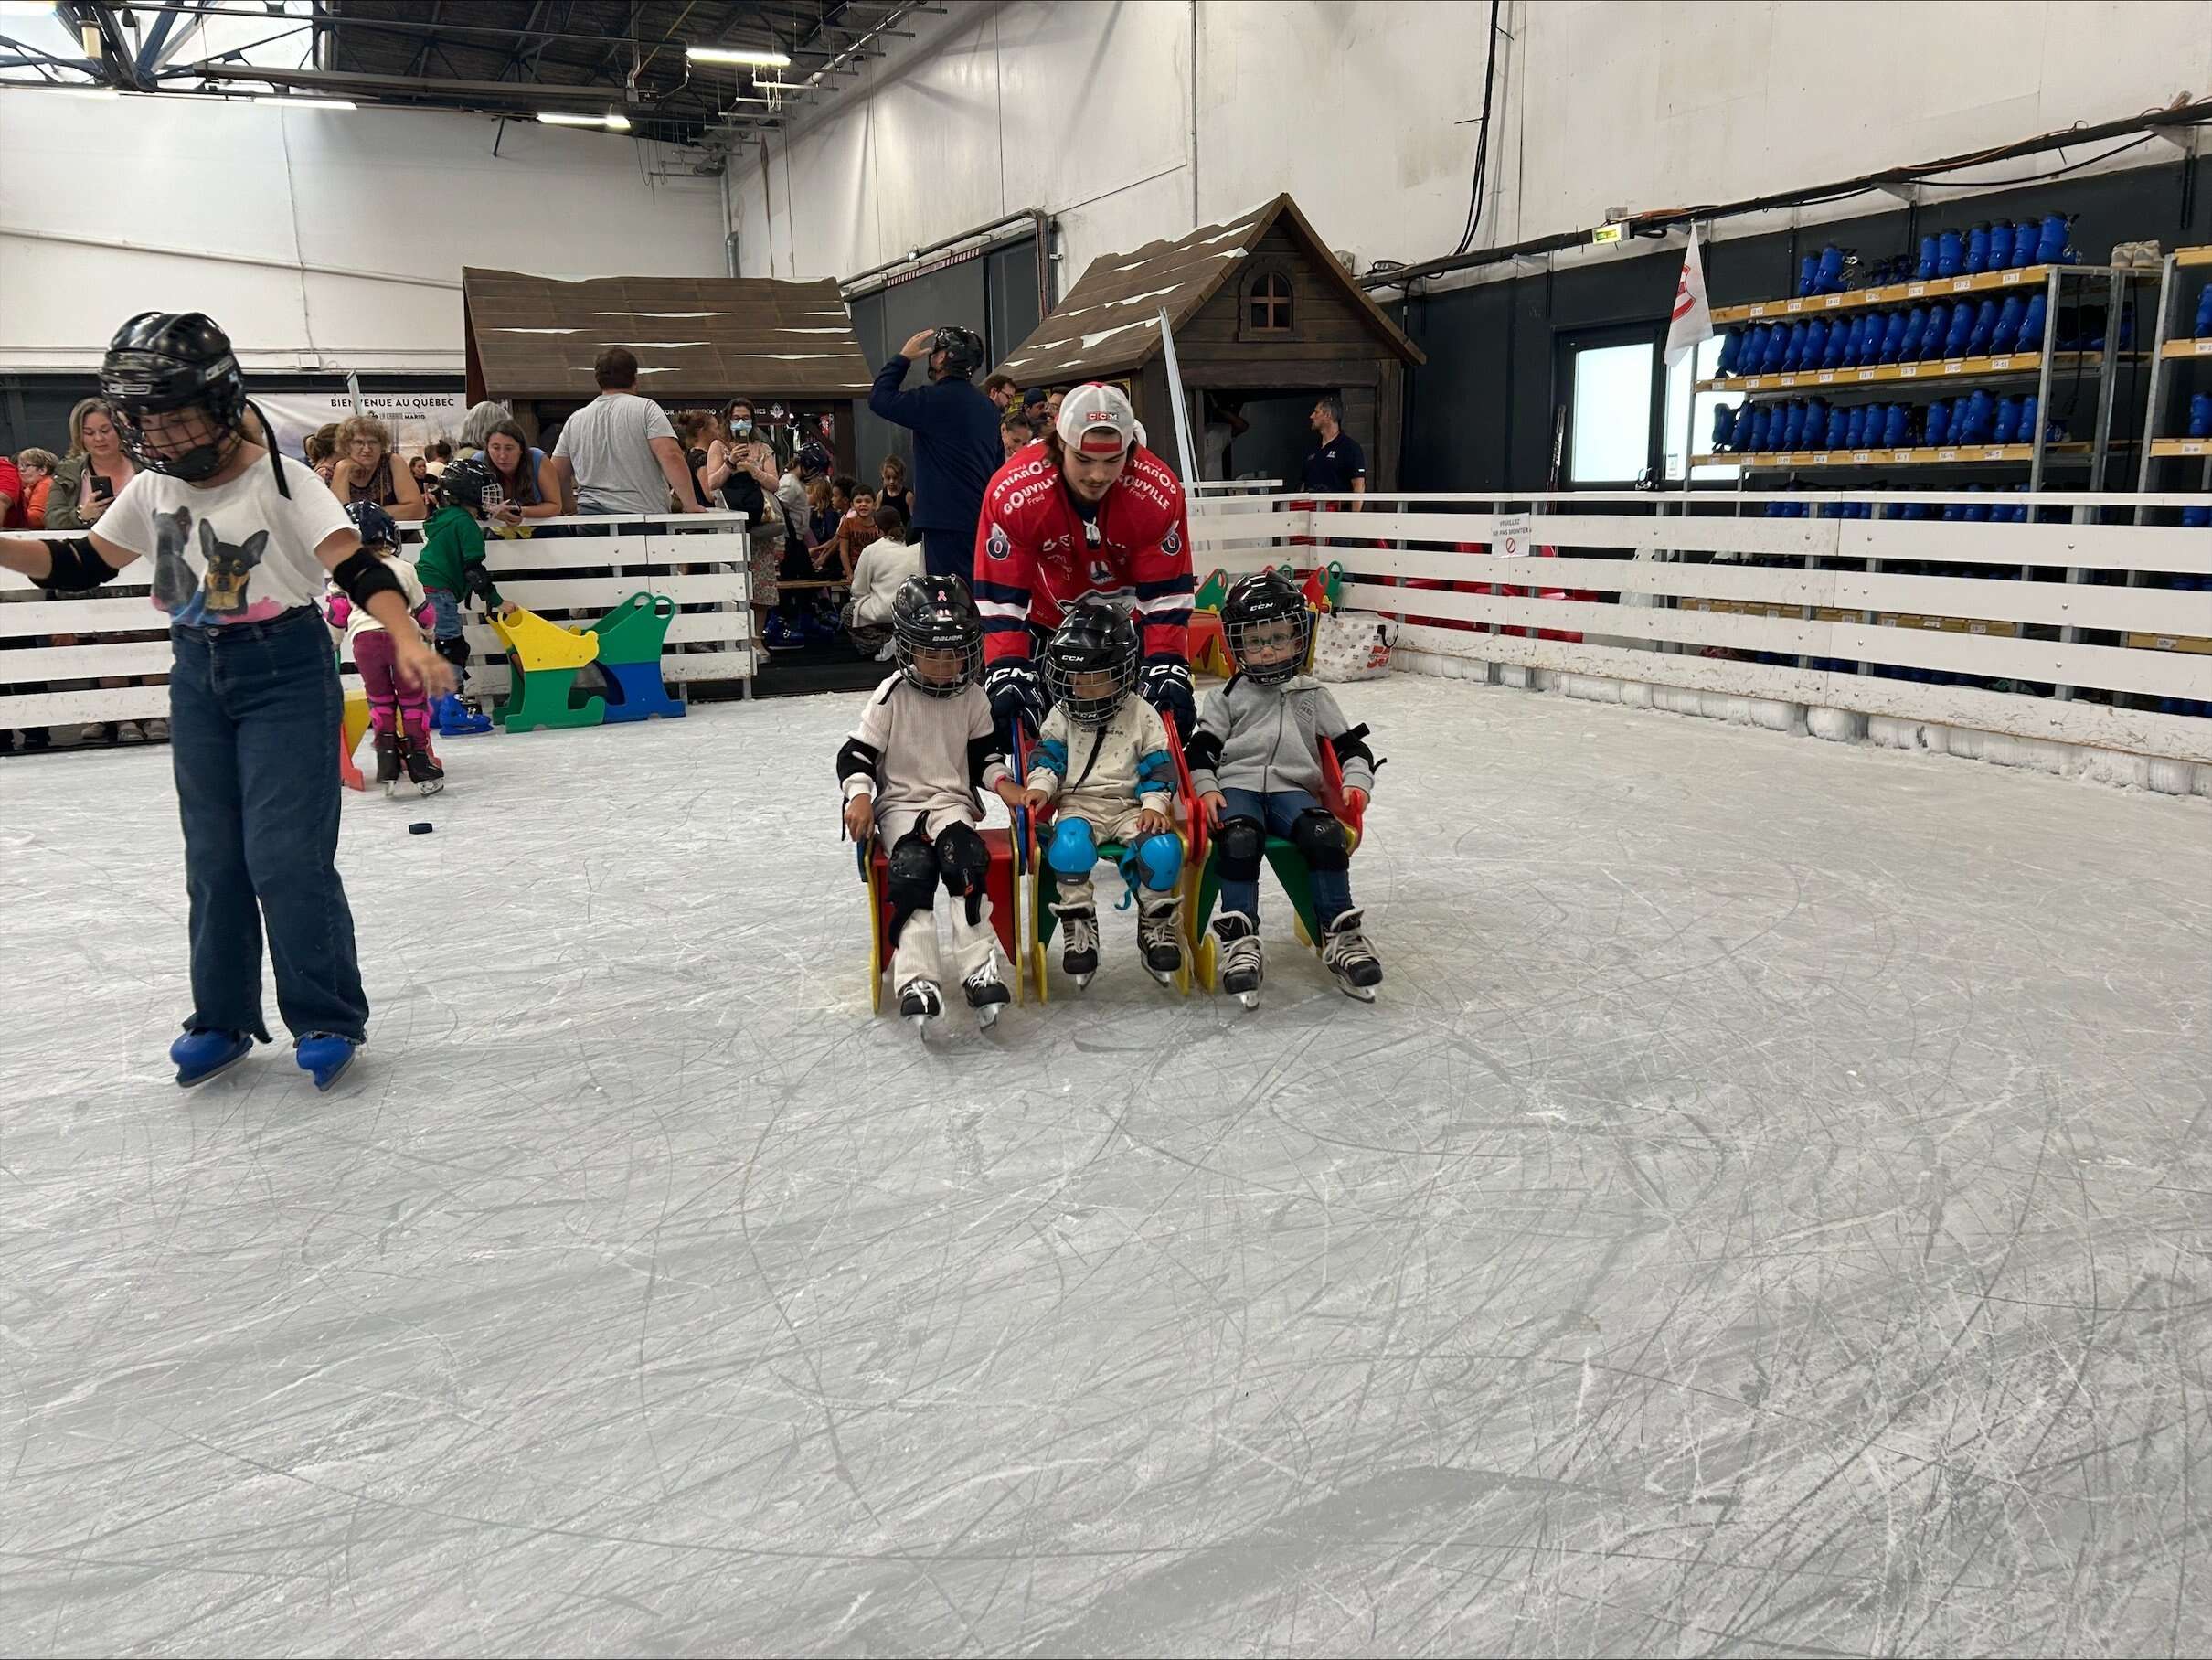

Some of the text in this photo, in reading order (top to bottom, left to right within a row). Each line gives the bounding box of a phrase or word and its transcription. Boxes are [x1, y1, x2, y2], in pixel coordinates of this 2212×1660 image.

[330, 396, 454, 409] BIENENUE AU QUÉBEC
[1089, 412, 1118, 420] CCM
[1250, 602, 1274, 612] CCM
[1148, 665, 1190, 680] CC
